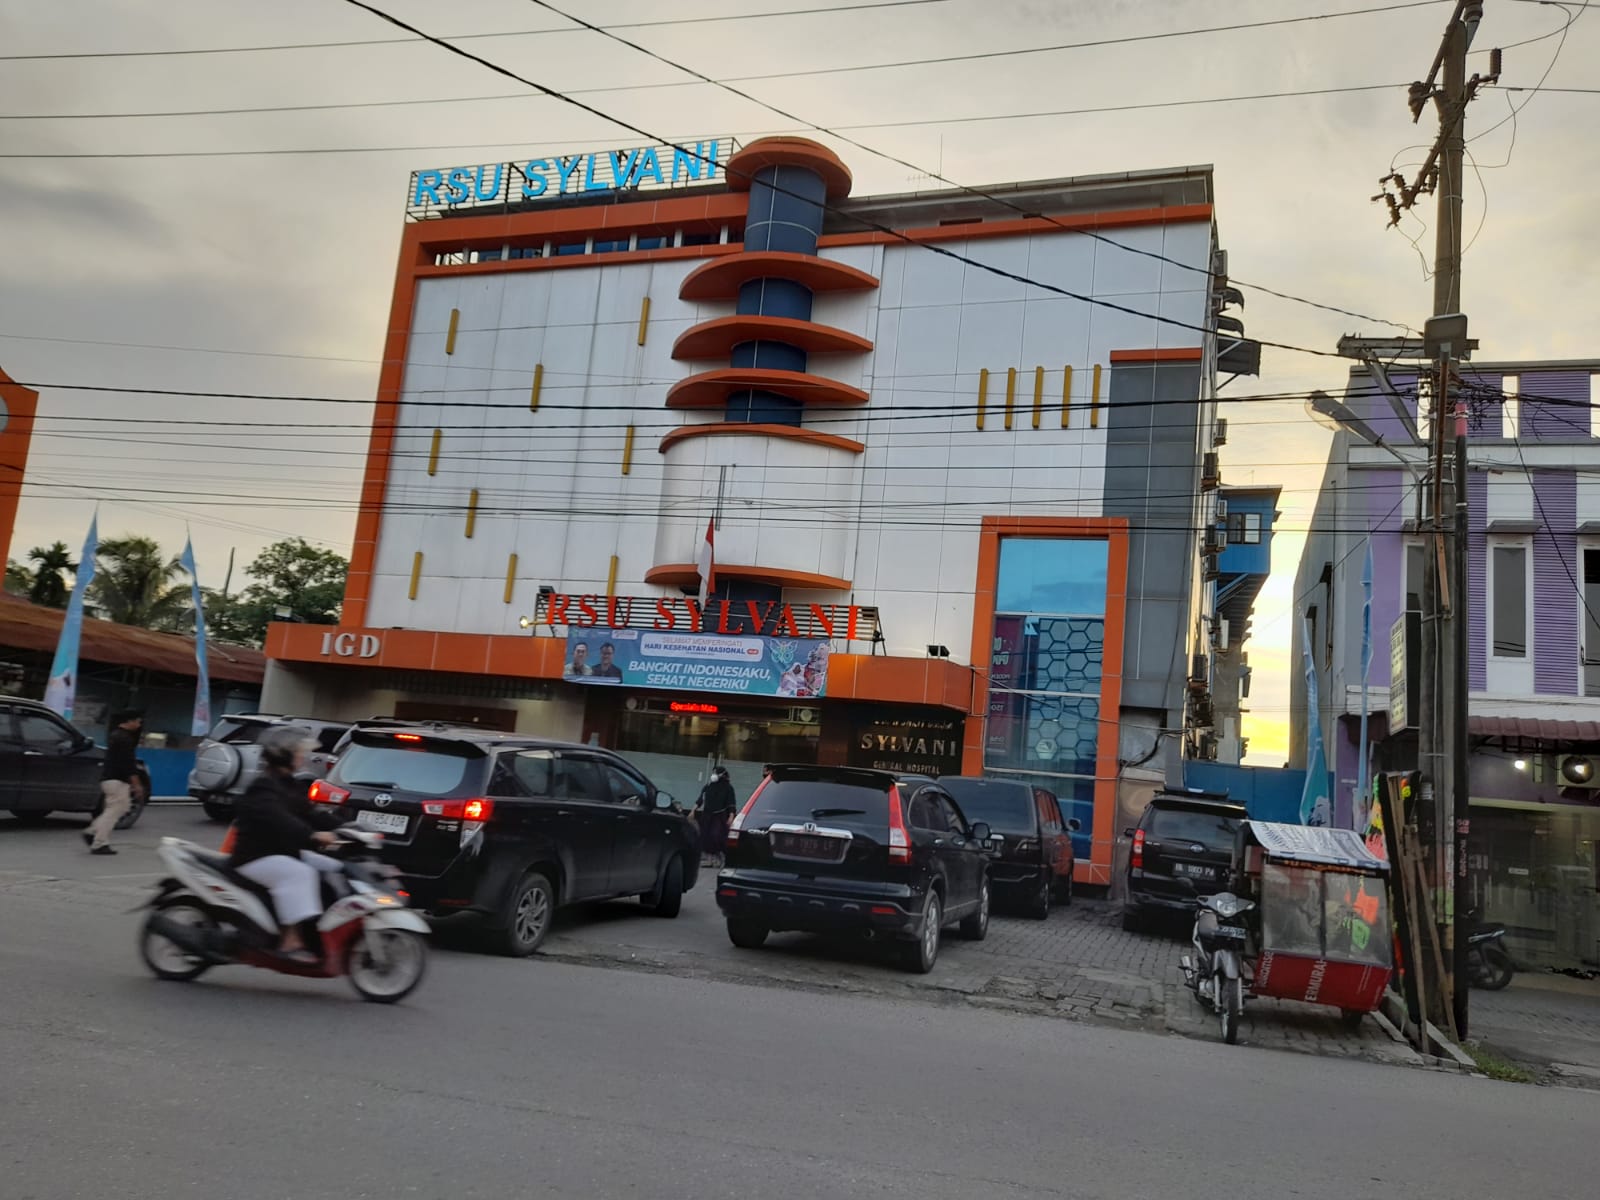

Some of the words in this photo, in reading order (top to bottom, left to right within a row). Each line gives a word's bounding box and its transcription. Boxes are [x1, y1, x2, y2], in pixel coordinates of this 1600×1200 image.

[414, 162, 503, 206] RSU
[522, 140, 719, 196] SYLVANI
[546, 593, 632, 629] RSU
[653, 596, 861, 640] SYLVANI
[320, 632, 380, 658] IGD
[664, 644, 706, 652] KESEHATAN
[708, 646, 745, 655] NASIONAL
[628, 660, 682, 673] BANGKIT
[683, 664, 771, 681] INDONESIAKU,
[646, 673, 685, 685] SEHAT
[687, 676, 749, 690] NEGERIKU
[861, 733, 956, 756] SYLVANI
[907, 763, 940, 775] HOSPITAL
